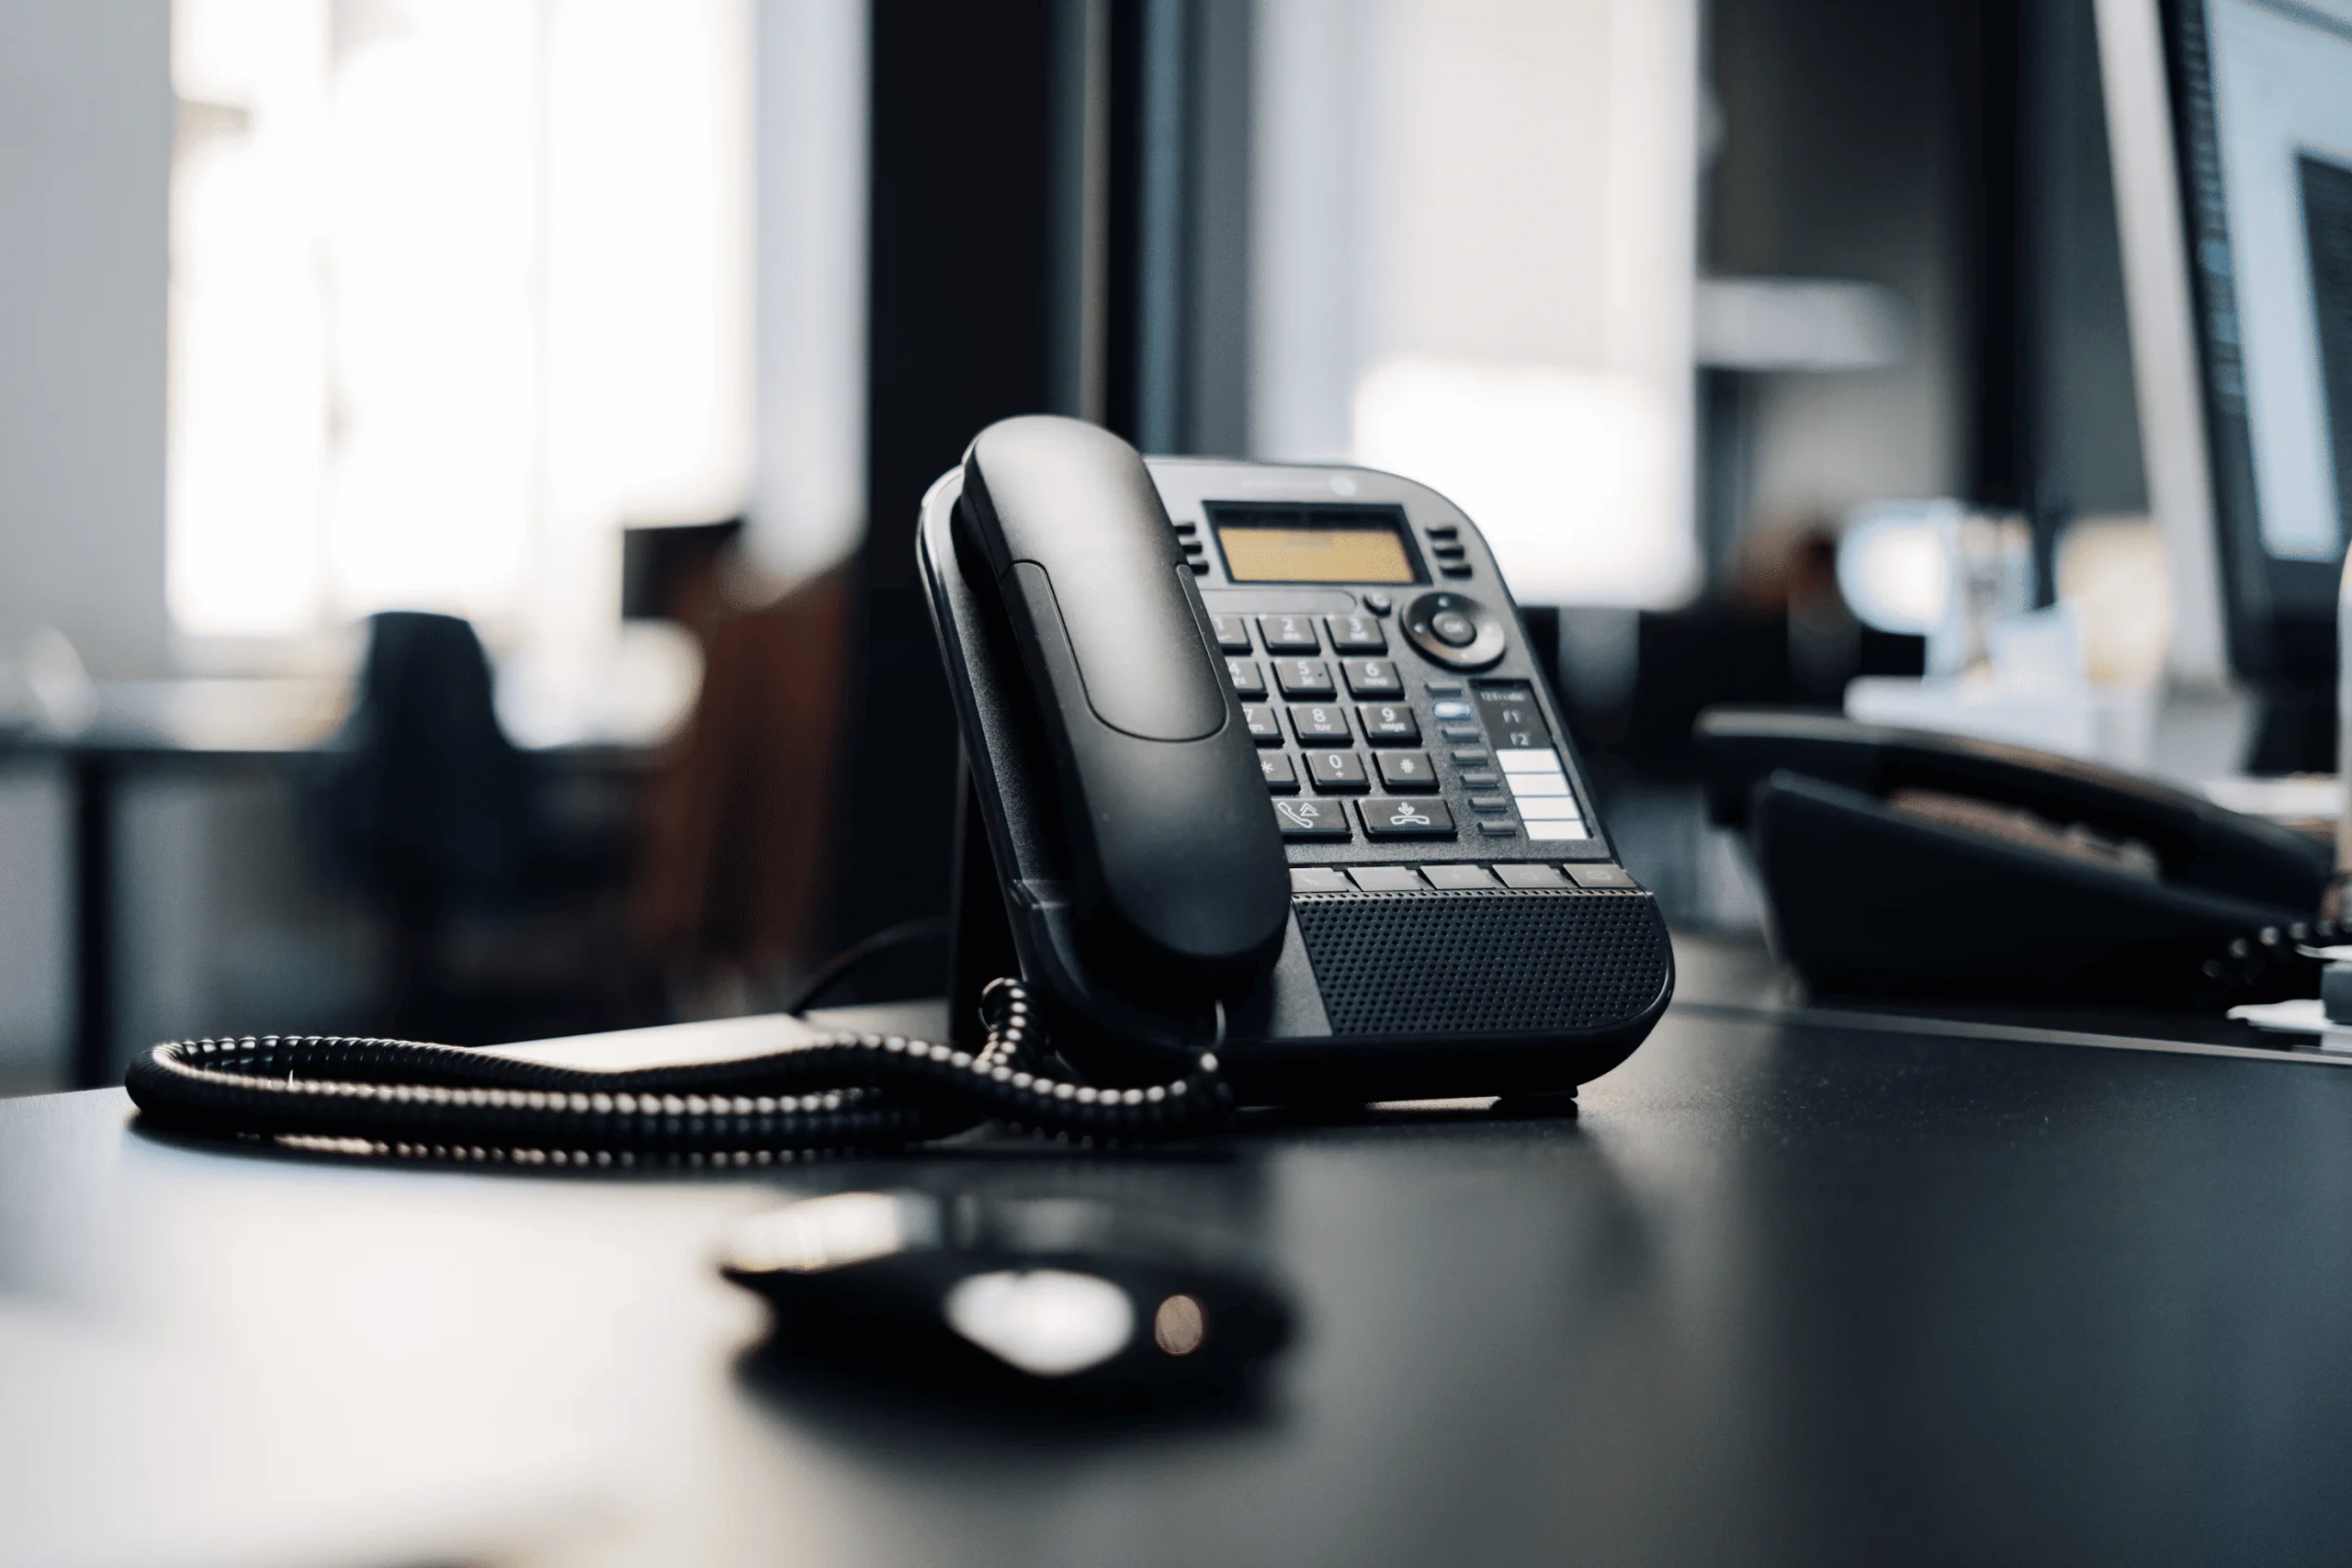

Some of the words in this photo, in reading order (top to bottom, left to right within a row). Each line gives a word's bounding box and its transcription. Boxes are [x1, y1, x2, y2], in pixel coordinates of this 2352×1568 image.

[1214, 618, 1224, 631] 1
[1282, 618, 1295, 631] 2
[1349, 618, 1362, 631] 3
[1229, 662, 1240, 675] 4
[1297, 660, 1310, 675] 5
[1365, 662, 1380, 677] 6
[1243, 708, 1253, 722] 7
[1312, 708, 1326, 722] 8
[1382, 707, 1395, 722] 9
[1314, 723, 1331, 731] tuv
[1380, 723, 1406, 732] wxyz
[1510, 731, 1530, 746] F2
[1329, 754, 1341, 769] 0
